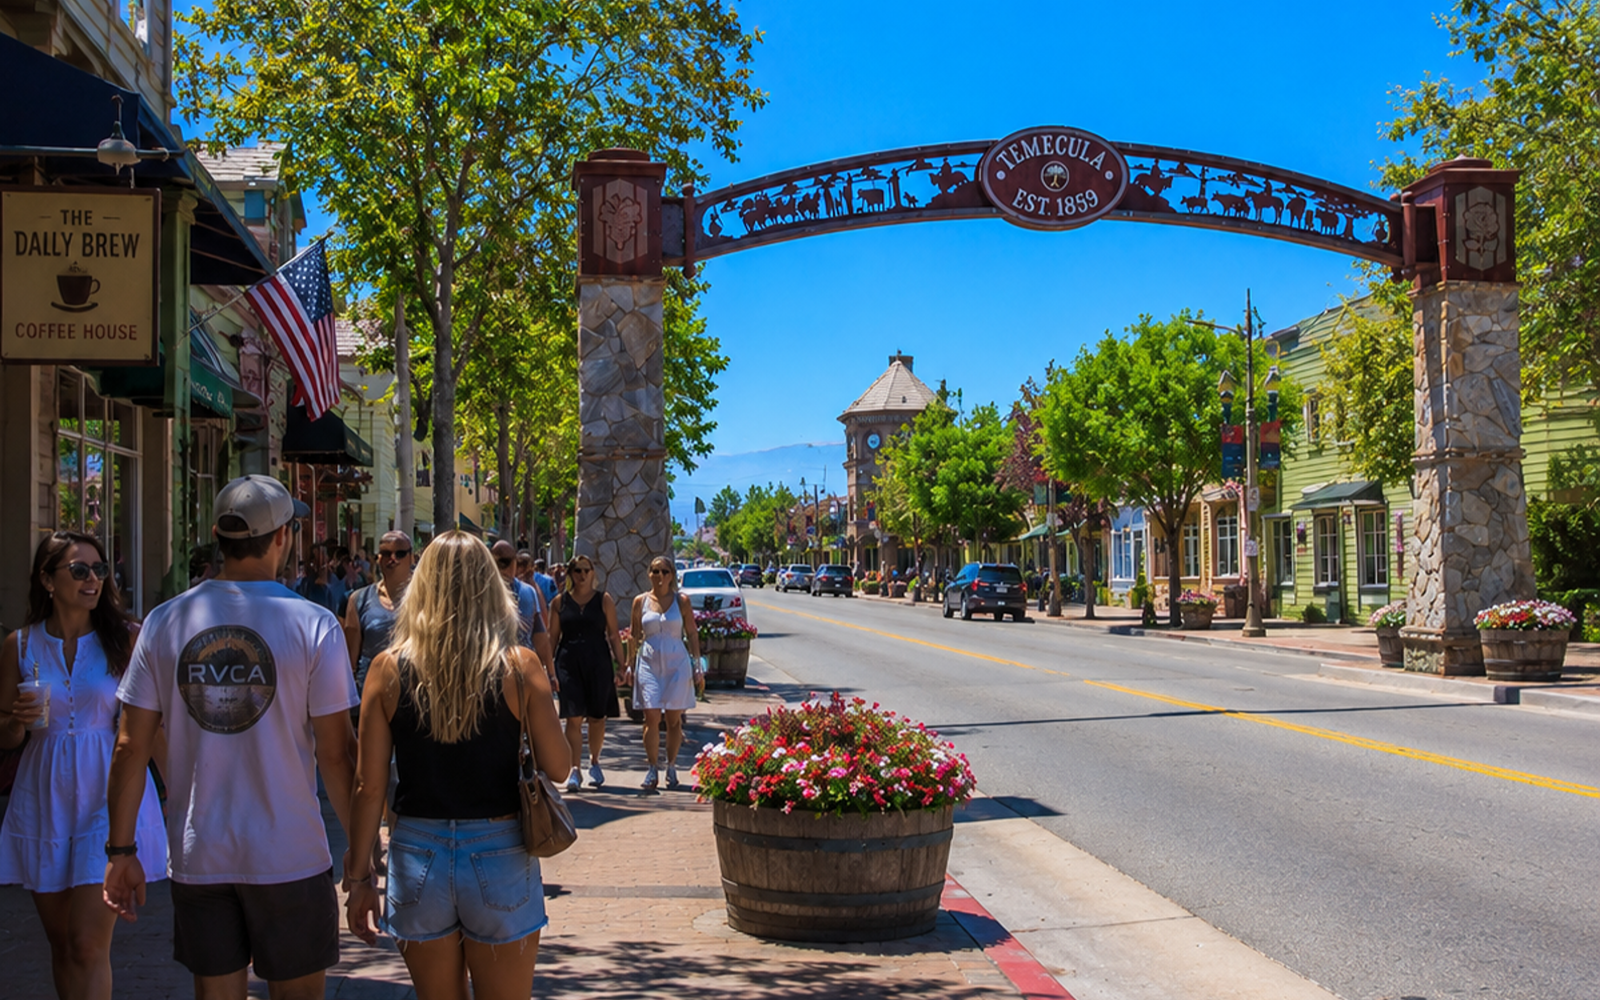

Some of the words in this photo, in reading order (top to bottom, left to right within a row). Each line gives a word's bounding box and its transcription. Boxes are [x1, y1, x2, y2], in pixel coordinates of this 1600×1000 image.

[996, 134, 1106, 171] TEMECULA
[1012, 188, 1051, 216] EST.
[1056, 189, 1099, 216] 1859
[60, 209, 93, 226] THE
[82, 232, 140, 258] BREW
[15, 322, 76, 340] COFFEE
[83, 323, 138, 340] HOUSE
[187, 664, 267, 684] RVCA
